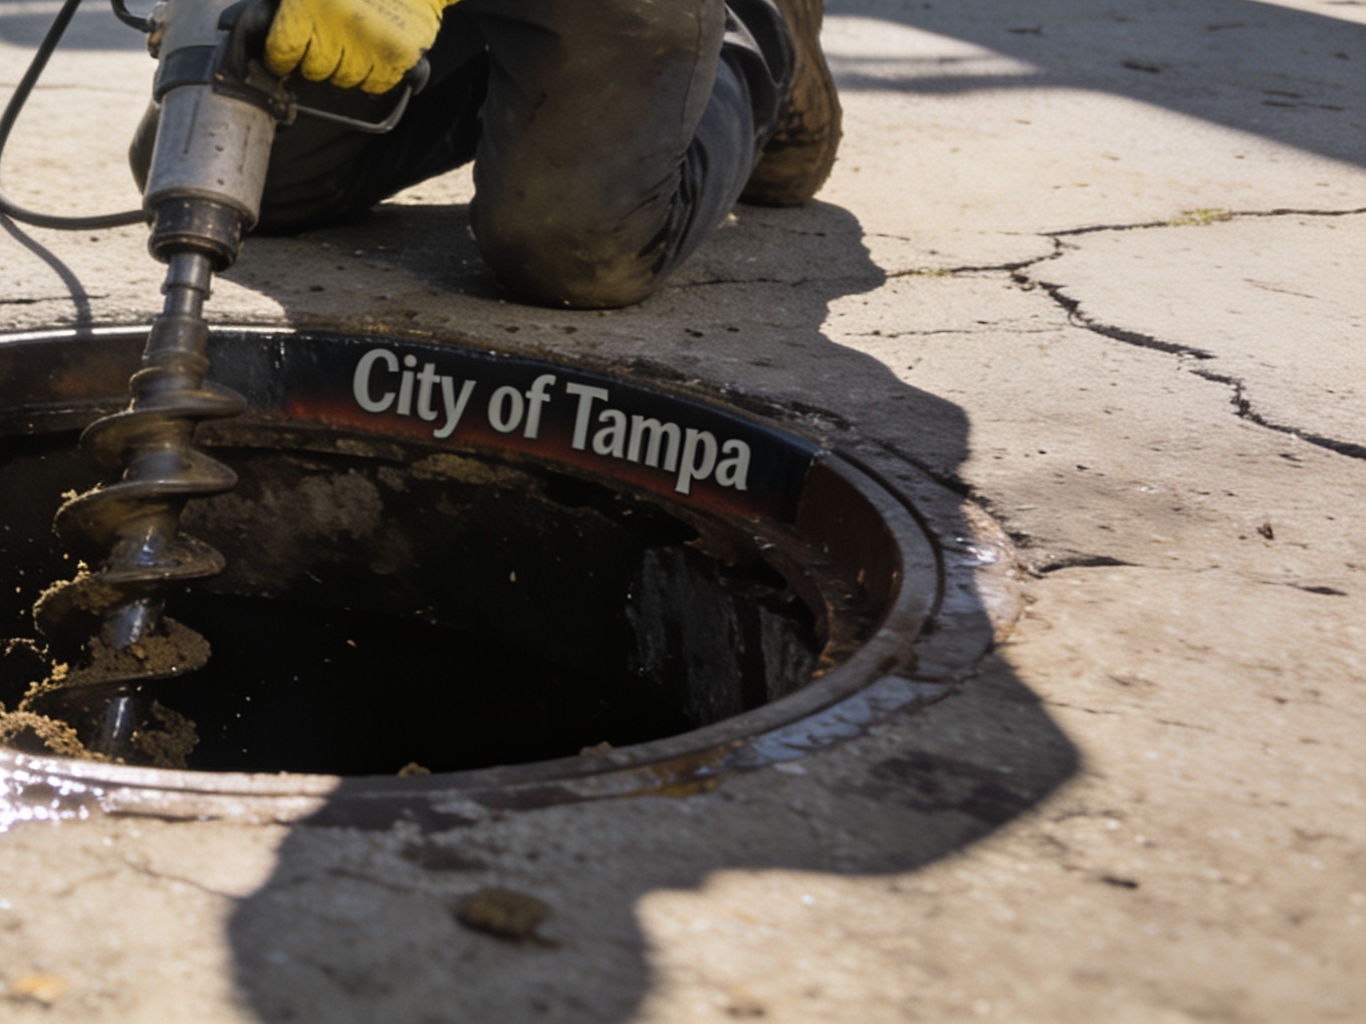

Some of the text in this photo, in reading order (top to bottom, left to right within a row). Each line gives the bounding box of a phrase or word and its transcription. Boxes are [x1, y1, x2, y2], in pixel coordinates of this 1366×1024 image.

[353, 348, 751, 494] City of Tampa
